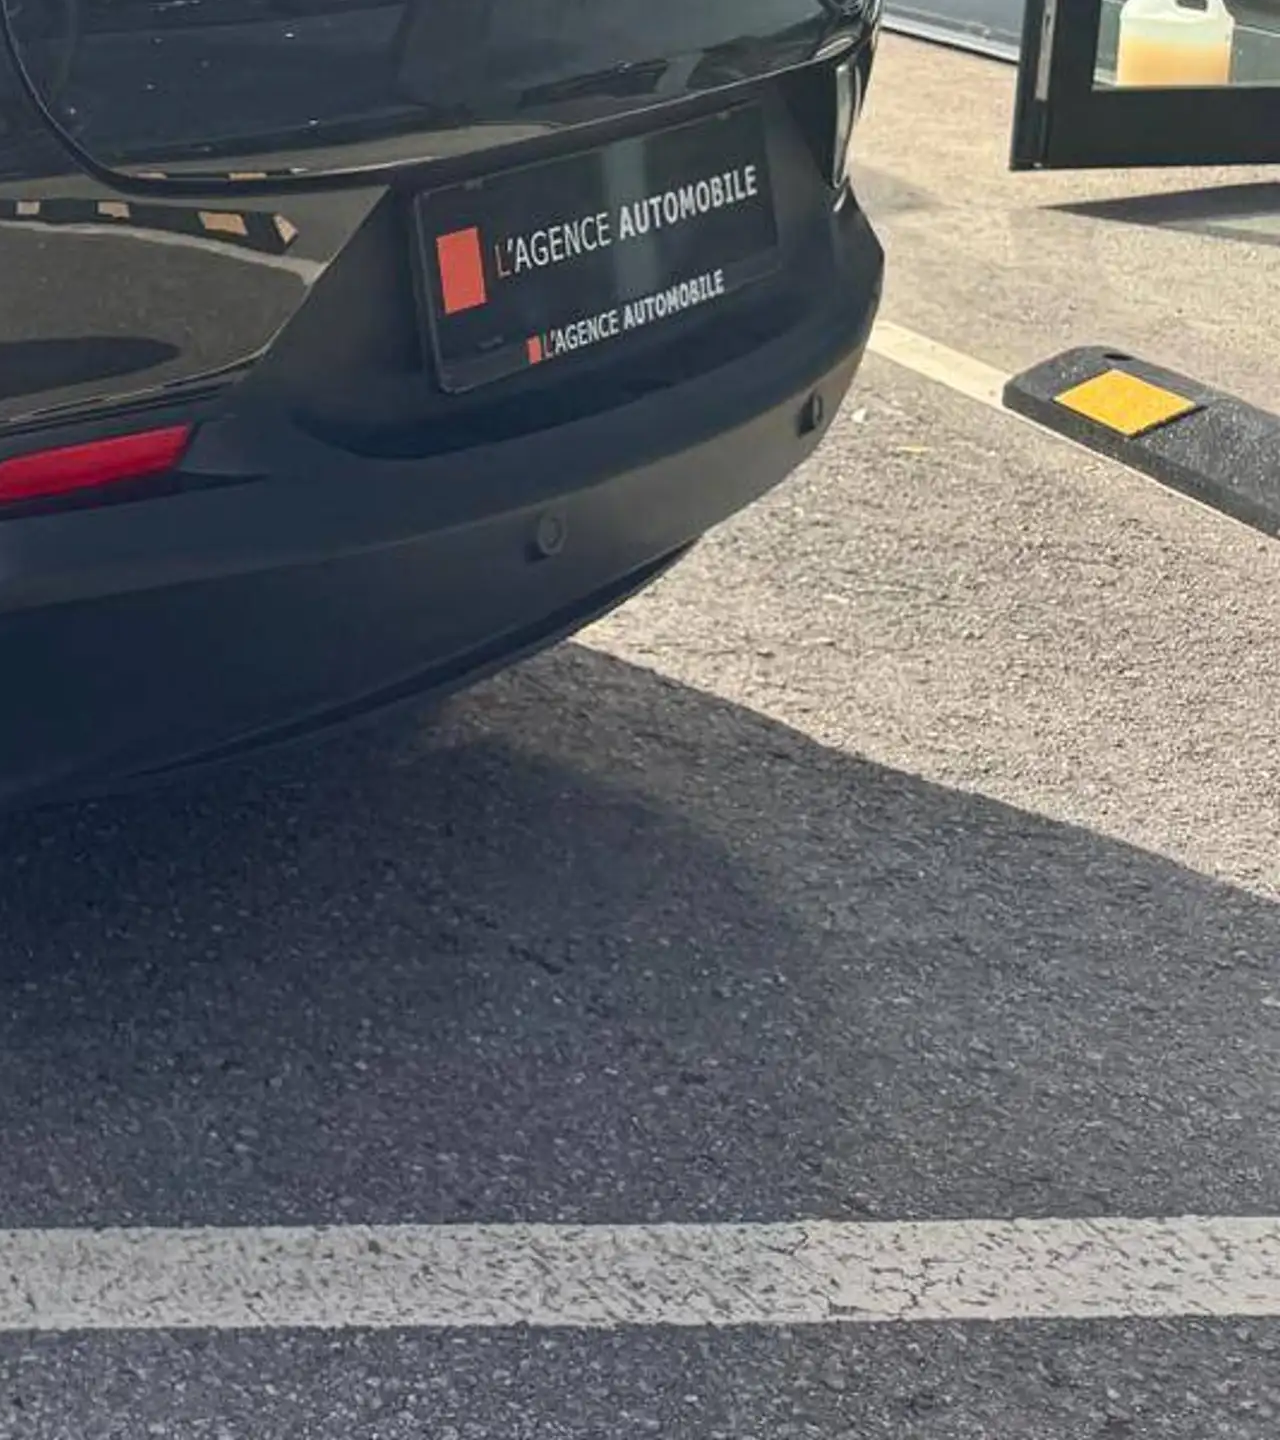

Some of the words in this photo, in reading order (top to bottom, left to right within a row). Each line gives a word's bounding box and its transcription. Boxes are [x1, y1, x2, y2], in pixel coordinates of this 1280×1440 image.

[494, 212, 612, 279] L'AGENCE
[619, 165, 758, 240] AUTOMOBILE
[543, 309, 620, 360] L'AGENCE
[623, 269, 725, 330] AUTOMOBILE
